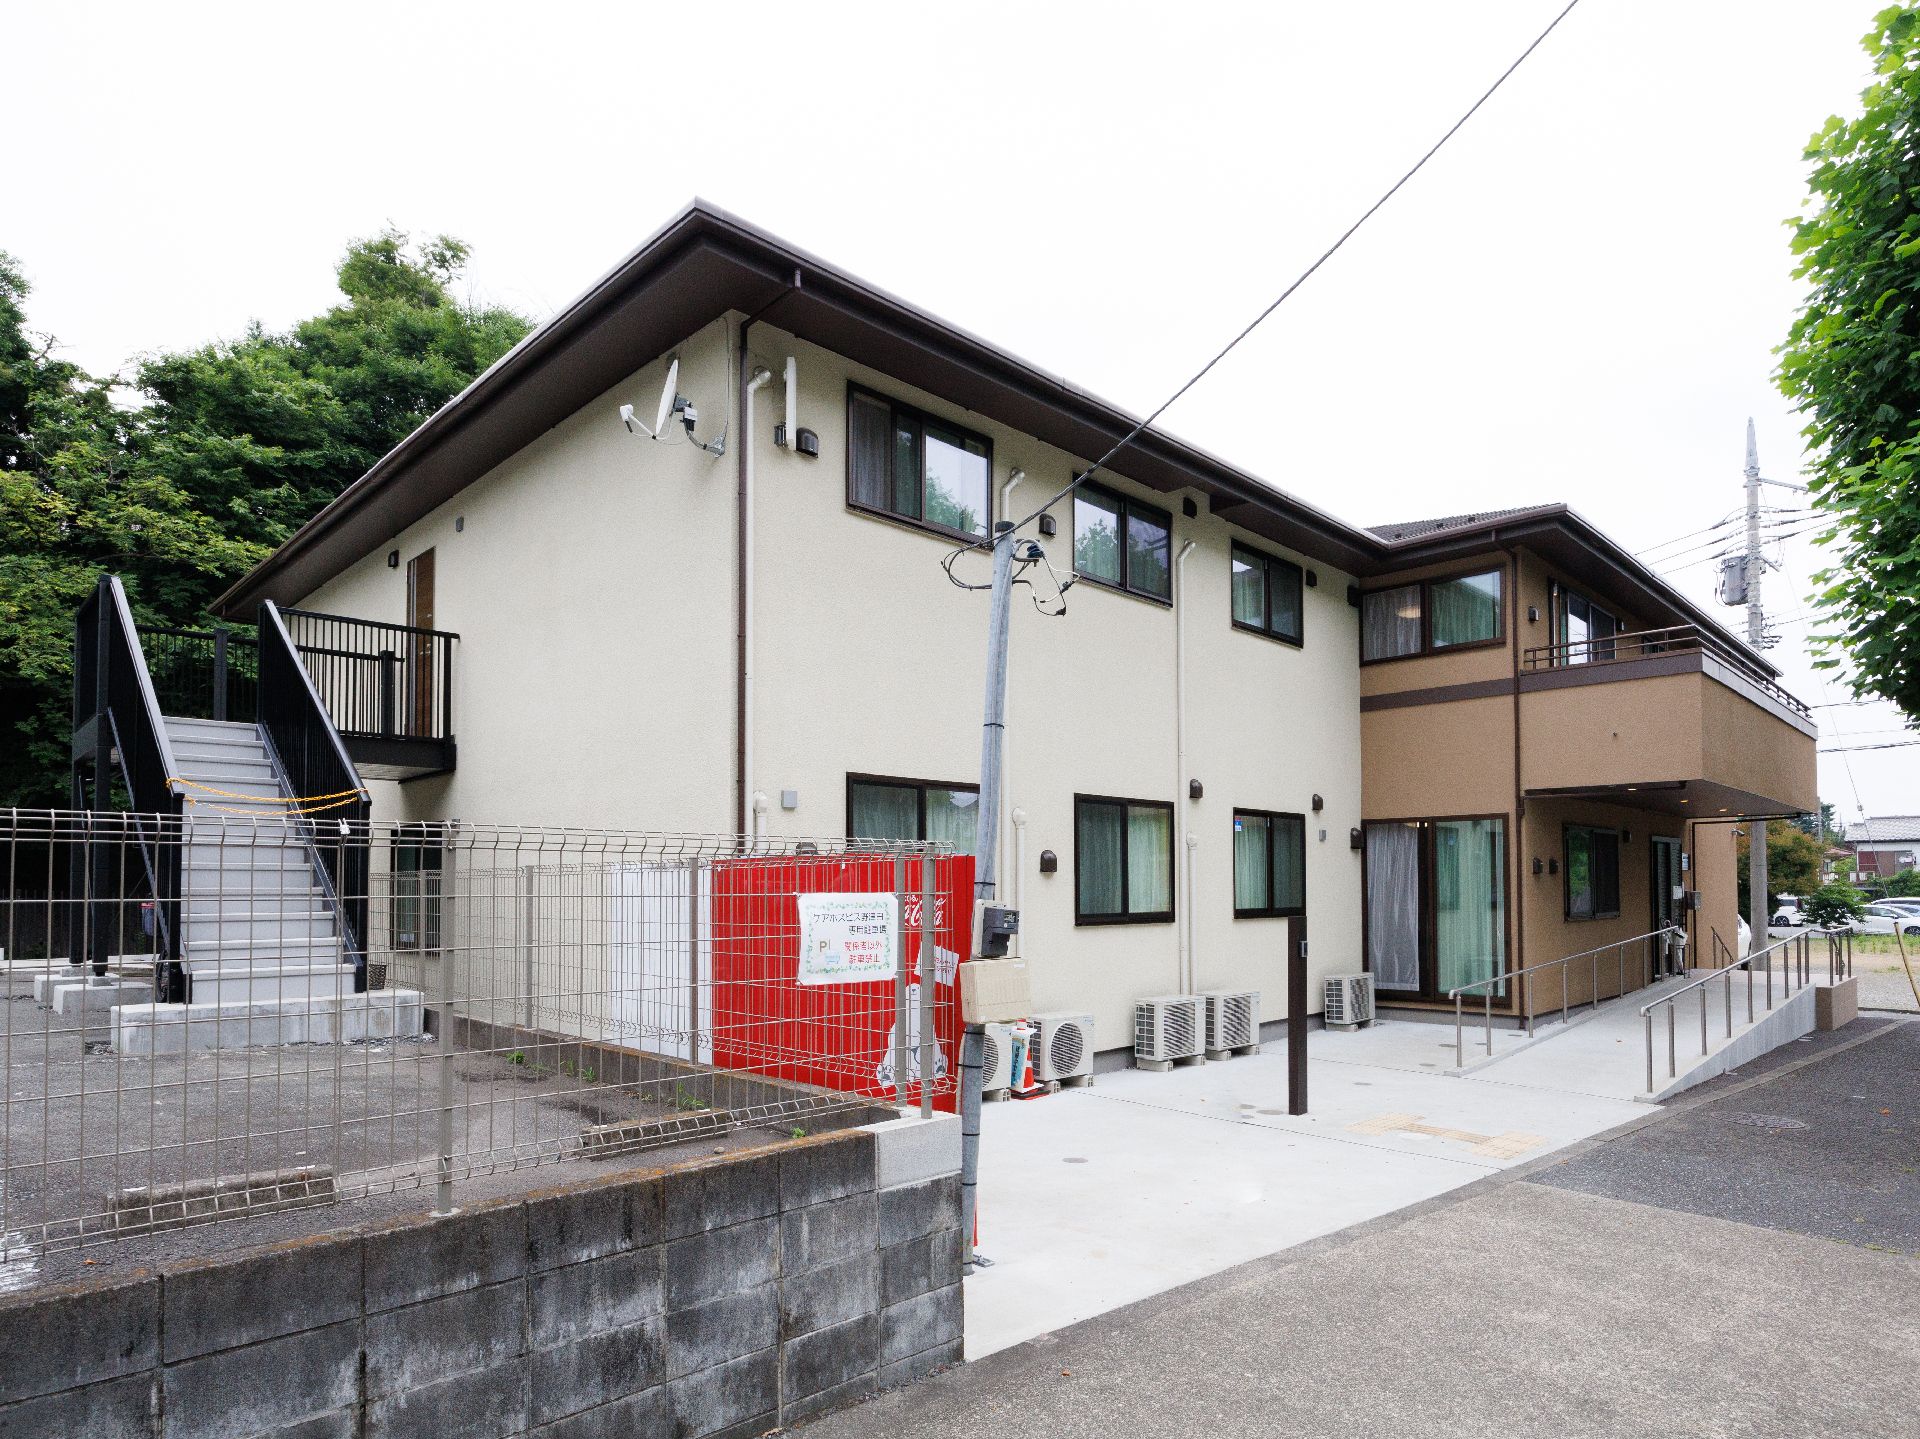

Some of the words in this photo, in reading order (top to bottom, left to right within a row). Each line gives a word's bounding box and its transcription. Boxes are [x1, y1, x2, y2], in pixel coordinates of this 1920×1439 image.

[849, 925, 887, 935] 専用駐車場
[844, 941, 883, 952] 関係者以外
[848, 953, 881, 964] 駐車禁止
